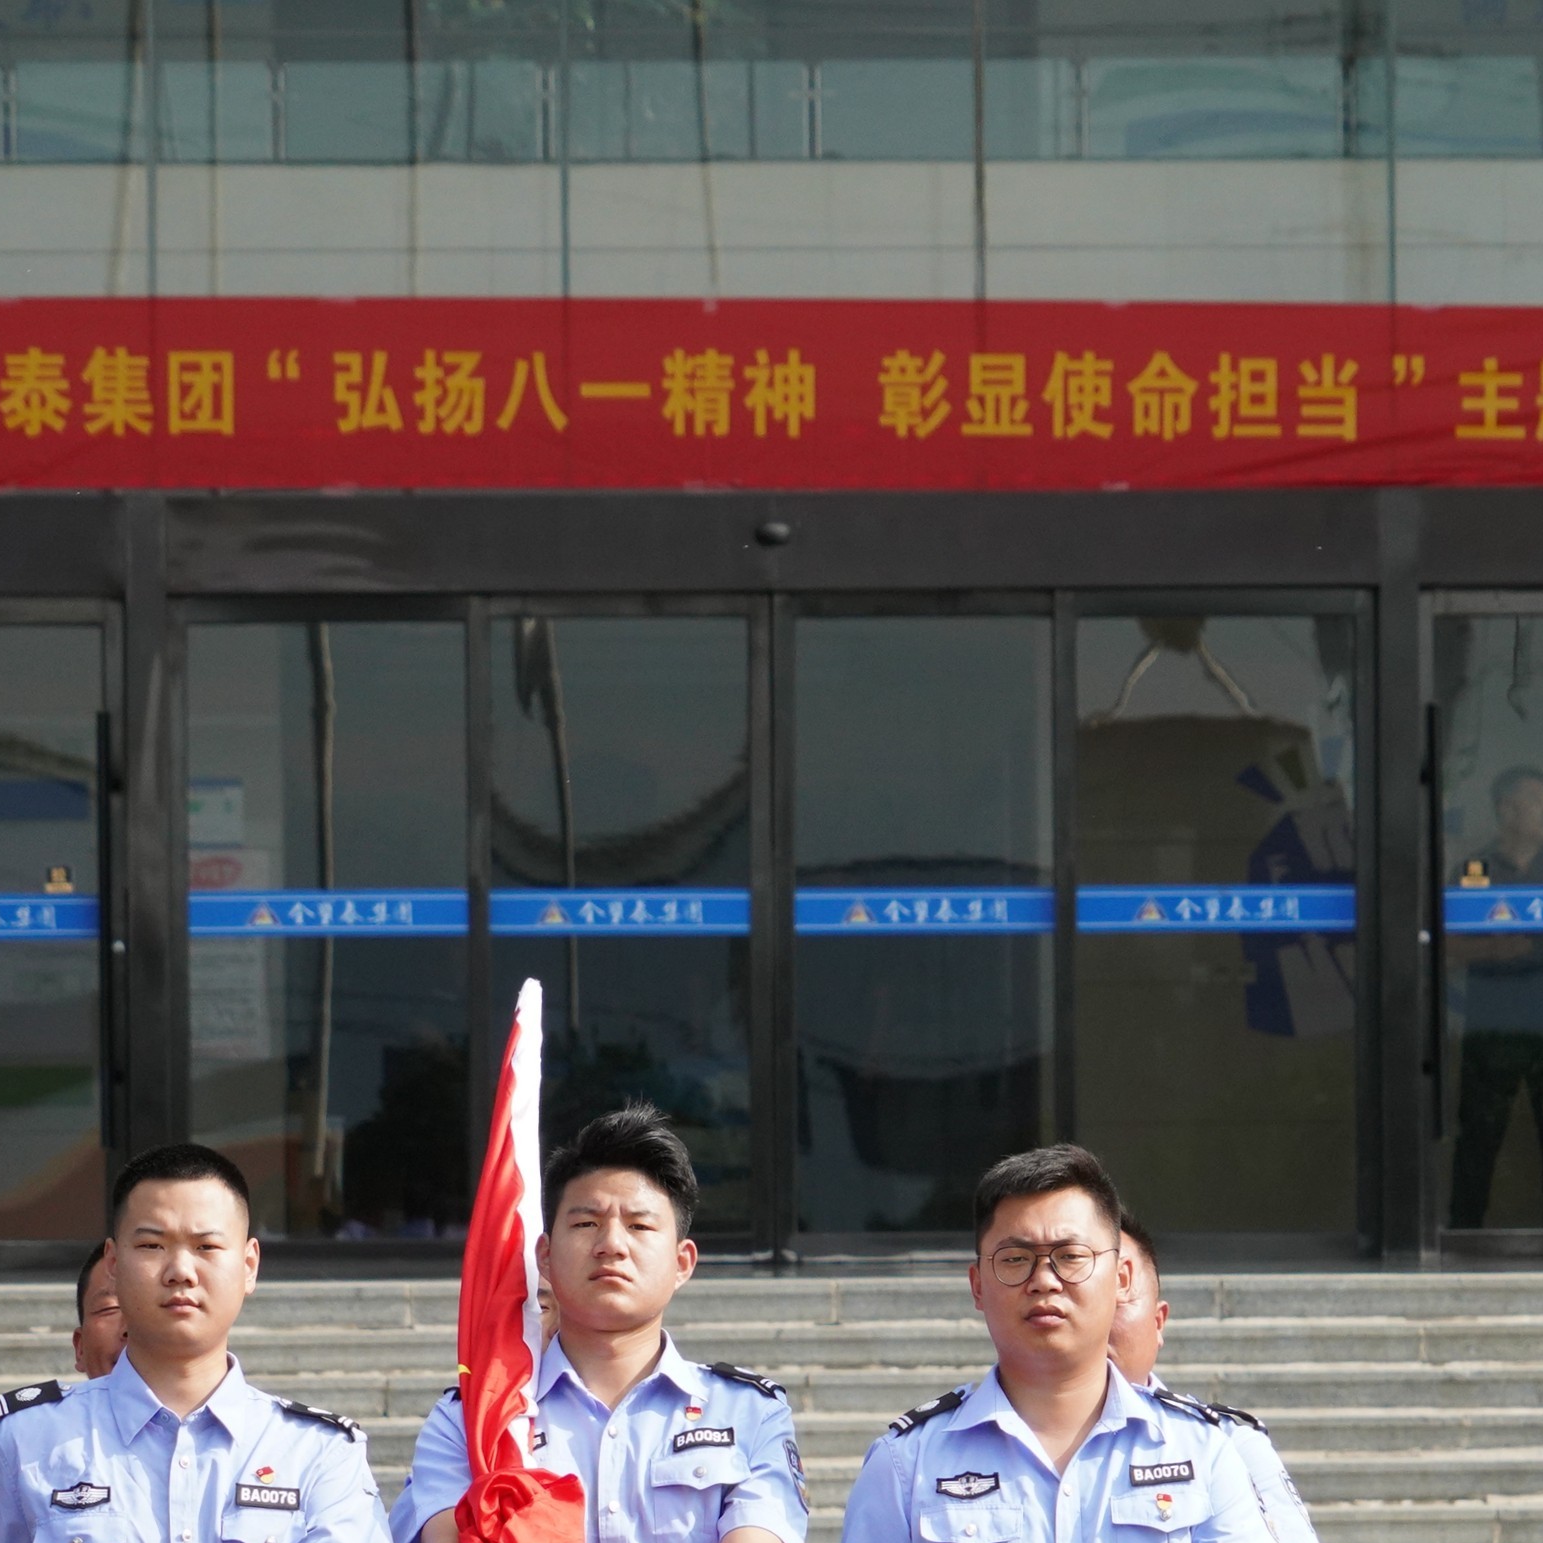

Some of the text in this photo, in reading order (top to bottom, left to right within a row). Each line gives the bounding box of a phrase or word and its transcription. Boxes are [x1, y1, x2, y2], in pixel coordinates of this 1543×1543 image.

[676, 1430, 731, 1448] BA0091
[1133, 1464, 1190, 1481] BA0070
[240, 1486, 298, 1505] BA0076
